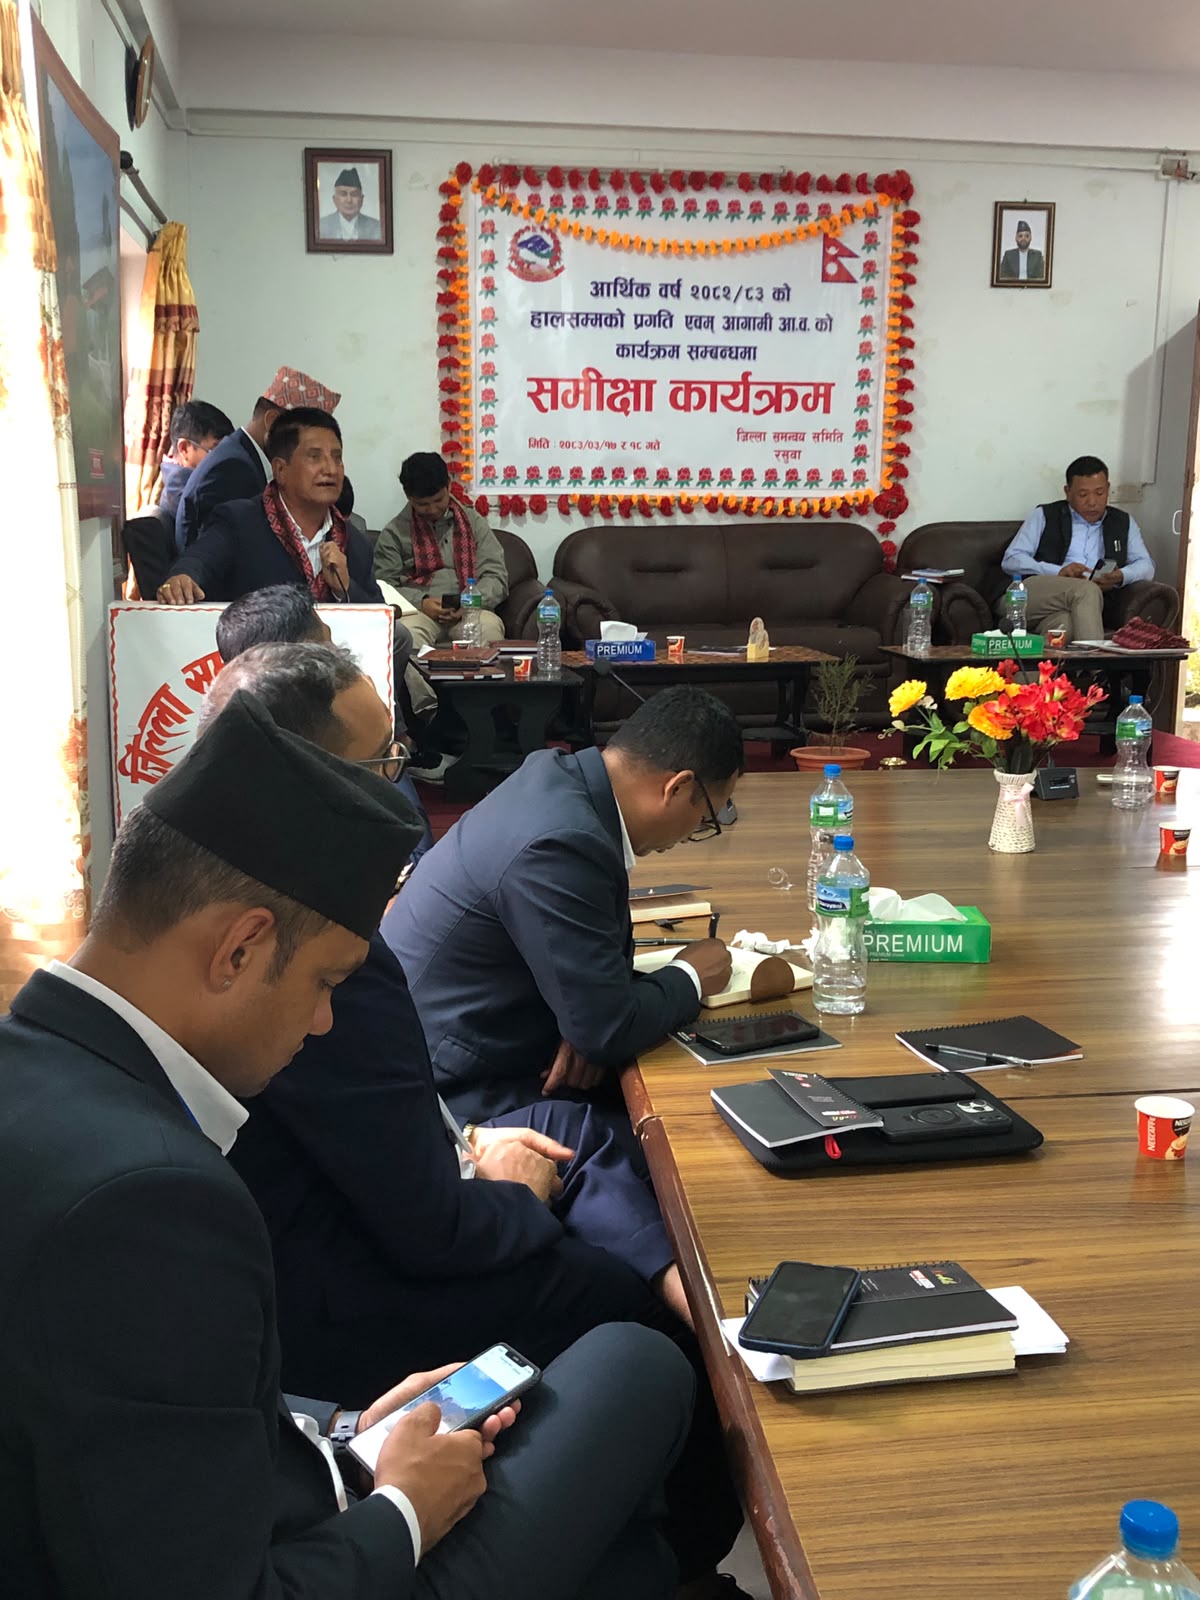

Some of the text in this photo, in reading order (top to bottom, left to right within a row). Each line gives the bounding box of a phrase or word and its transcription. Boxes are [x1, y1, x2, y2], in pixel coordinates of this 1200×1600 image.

[589, 276, 792, 304] आर्थिक वर्ष २०८२/८३ को
[530, 307, 834, 334] हालसम्मको प्रगति एवम् आगामी आ.व. को
[615, 339, 758, 361] कार्यक्रम सम्बन्धमा
[526, 366, 836, 417] समीक्षा कार्यक्रम
[736, 427, 844, 444] जिल्ला समन्वय समिति
[773, 449, 802, 465] रसुवा
[597, 644, 643, 656] PREMIUM
[862, 933, 963, 953] PREMIUM
